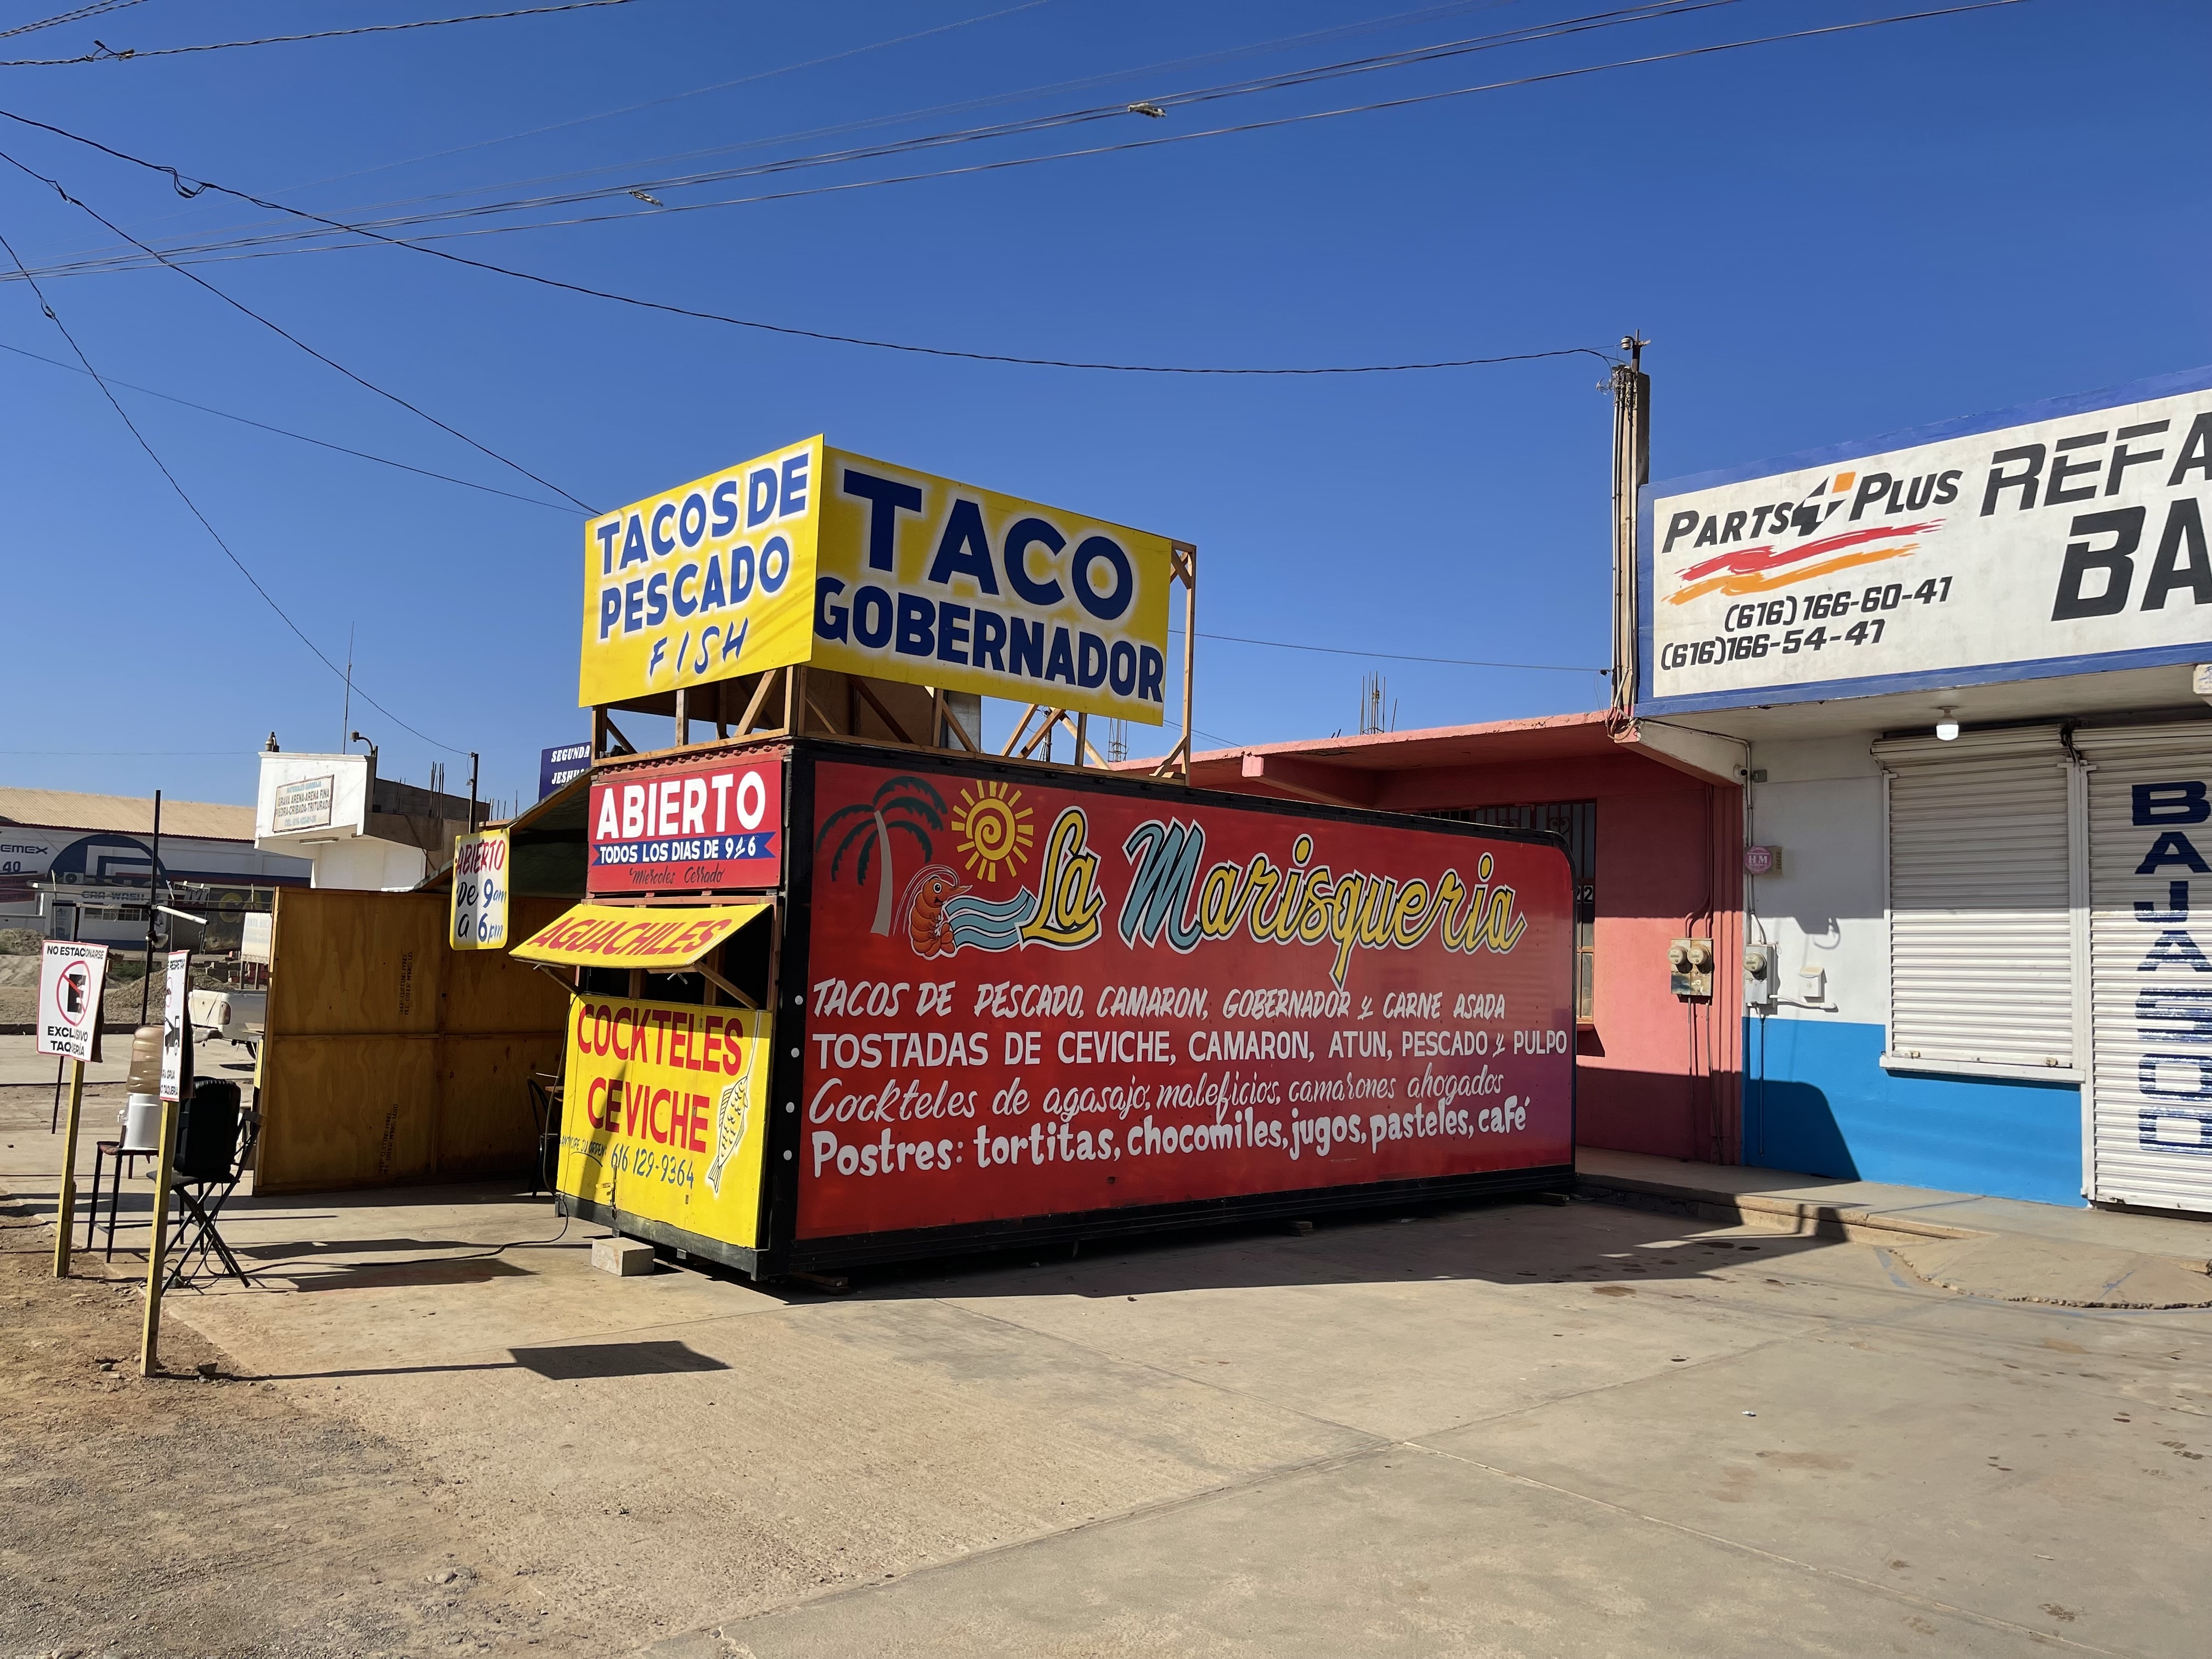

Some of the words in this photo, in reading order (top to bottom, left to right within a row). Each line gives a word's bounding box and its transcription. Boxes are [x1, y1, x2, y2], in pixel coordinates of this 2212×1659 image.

[1979, 411, 2212, 517] REFA
[597, 480, 738, 575] TACOS
[747, 453, 810, 529] DE
[843, 468, 1133, 621] TACO
[1661, 501, 1795, 554] PARTS
[1848, 470, 1963, 522] PLUS
[600, 535, 790, 640] PESCADO
[2051, 496, 2212, 622] BA
[650, 616, 749, 678] FISH
[814, 577, 1164, 703] GOBERNADOR
[551, 745, 590, 763] SEGUNDA
[551, 769, 585, 785] JESHU
[278, 795, 290, 806] GRAVA
[320, 787, 329, 799] FINA
[596, 771, 766, 840] ABIERTO
[455, 839, 506, 876] ABIERTO
[600, 844, 638, 864] TODOS
[642, 842, 669, 862] LOS
[672, 840, 701, 861] DIAS
[704, 839, 719, 859] DE
[725, 838, 733, 859] 9
[748, 836, 756, 856] 6
[684, 862, 725, 884] Cerrado
[2131, 781, 2212, 972] BAJA
[1020, 806, 1107, 951] La
[1117, 816, 1528, 990] Marisqueria
[47, 945, 59, 955] NO
[526, 917, 732, 956] AGUACHILES
[812, 977, 910, 1018] TACOS
[916, 980, 956, 1017] DE
[974, 980, 1085, 1019] PESCADO,
[1096, 985, 1209, 1020] CAMARON,
[1222, 988, 1351, 1020] GOBERNADOR
[1383, 991, 1444, 1019] CARNE
[1453, 992, 1506, 1020] ASADA
[577, 1004, 743, 1076] COCKTELES
[812, 1032, 989, 1070] TOSTADAS
[1004, 1031, 1042, 1065] DE
[1058, 1031, 1177, 1066] CEVICHE,
[1188, 1030, 1316, 1063] CAMARON,
[1328, 1030, 1393, 1062] ATUN,
[1402, 1030, 1488, 1058] PESCADO
[1513, 1030, 1568, 1056] PULPO
[588, 1076, 710, 1154] CEVICHE
[809, 1077, 979, 1124] Cockteles
[992, 1076, 1030, 1115] de
[1042, 1075, 1151, 1123] agasajo,
[1156, 1071, 1281, 1125] maleficios,
[1288, 1071, 1397, 1103] camarones
[1407, 1062, 1505, 1106] ahogados
[611, 1143, 630, 1172] 616
[633, 1147, 695, 1189] 129-9364
[811, 1127, 963, 1178] Postres:
[973, 1121, 1121, 1169] tortitas,
[1127, 1107, 1288, 1156] chocomiles,
[1289, 1107, 1367, 1161] jugos,
[1369, 1097, 1475, 1154] pasteles,
